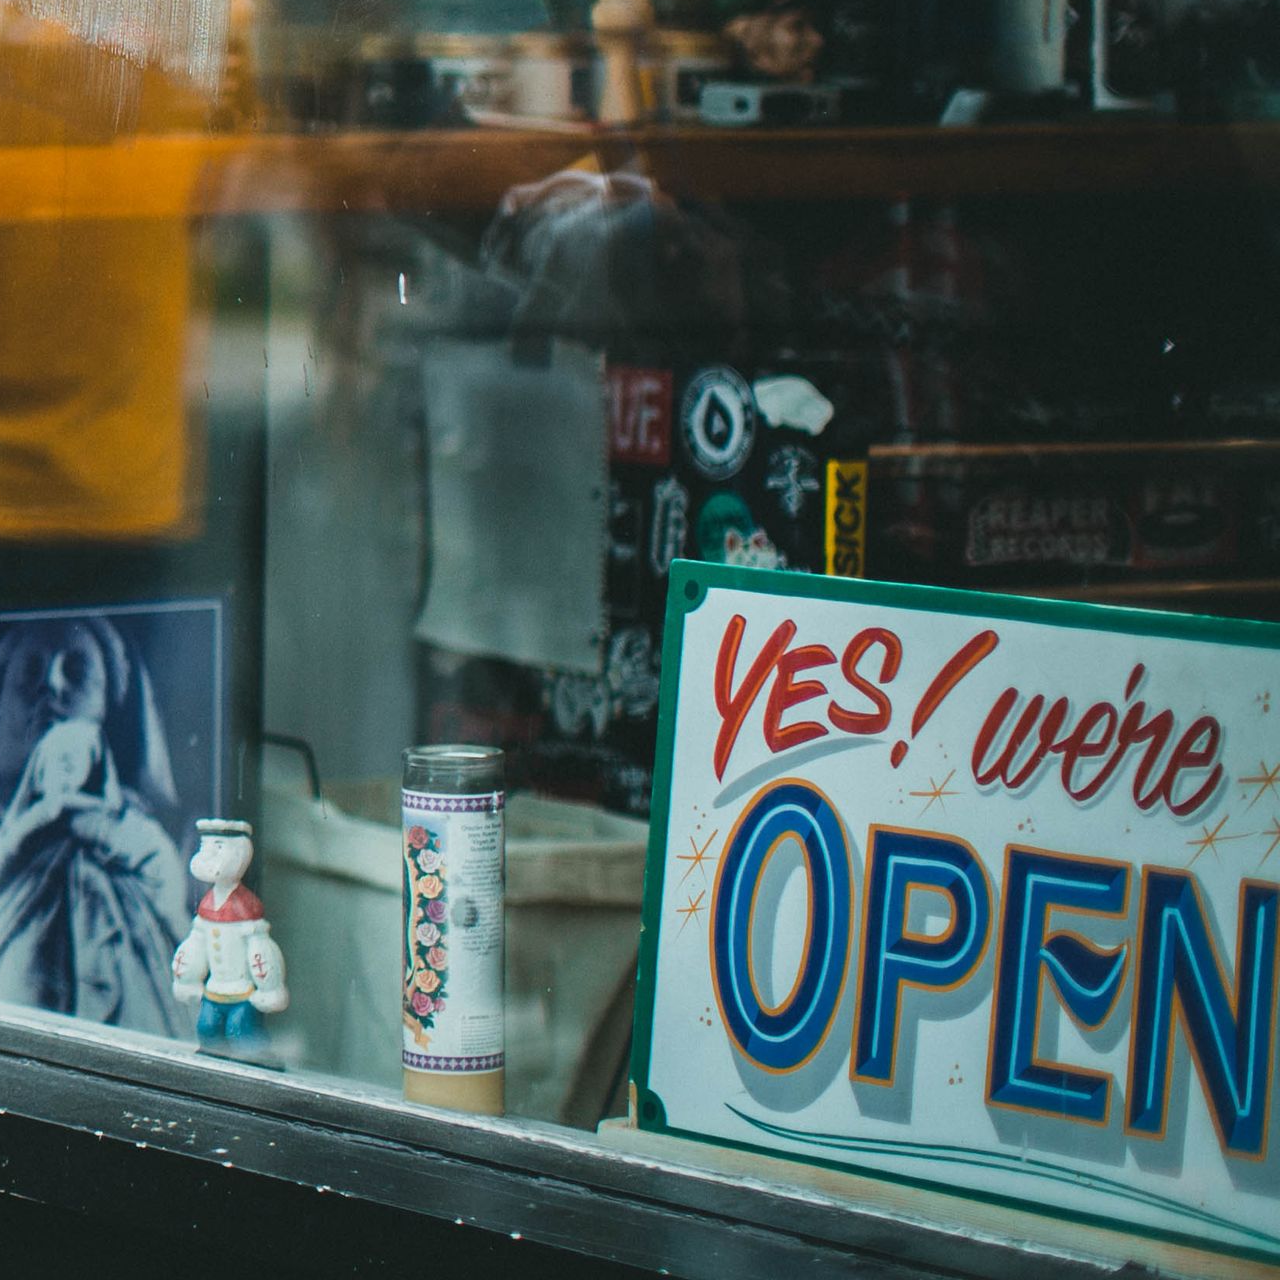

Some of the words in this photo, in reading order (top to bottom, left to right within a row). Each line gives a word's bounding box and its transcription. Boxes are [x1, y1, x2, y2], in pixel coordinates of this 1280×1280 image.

[833, 468, 862, 577] SICK
[713, 612, 1000, 784] YES!
[971, 662, 1224, 817] we're
[709, 776, 1280, 1162] OPEN
